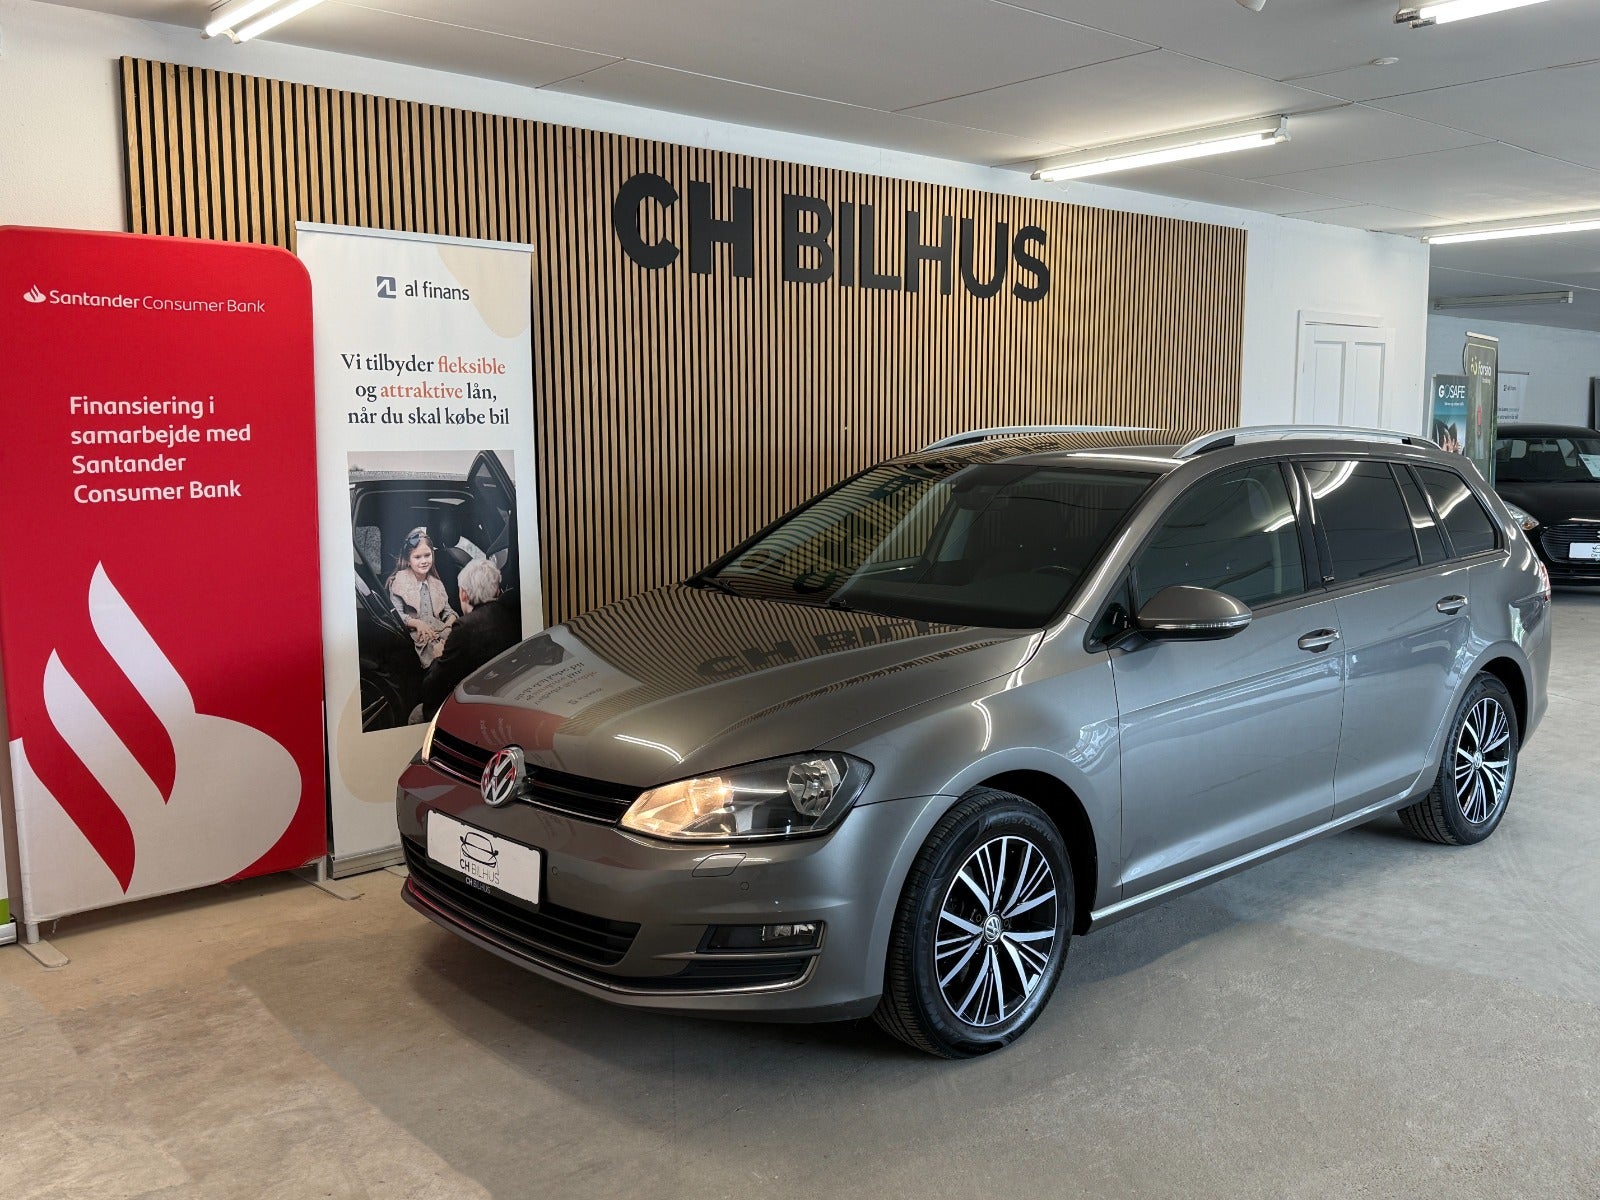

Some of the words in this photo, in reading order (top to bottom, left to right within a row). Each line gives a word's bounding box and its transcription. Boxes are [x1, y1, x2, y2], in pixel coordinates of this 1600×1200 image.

[614, 172, 752, 278] CH
[784, 193, 1050, 302] BILHUS
[49, 289, 140, 309] Santander
[142, 296, 224, 312] Consumer
[227, 299, 266, 313] Bank
[404, 279, 418, 297] al
[422, 280, 470, 301] finans
[340, 353, 362, 370] Vi
[366, 353, 434, 376] tilbyder
[438, 355, 506, 375] fleksible
[355, 384, 377, 402] og
[380, 381, 463, 399] attraktive
[467, 382, 497, 402] lån,
[69, 395, 204, 419] Finansiering
[208, 395, 215, 414] i
[347, 406, 377, 424] når
[380, 406, 403, 424] du
[408, 406, 441, 424] skal
[444, 406, 486, 425] købe
[489, 407, 510, 425] bil
[70, 424, 201, 448] samarbejde
[205, 423, 251, 442] med
[71, 453, 187, 475] Santander
[73, 483, 185, 504] Consumer
[189, 480, 242, 499] Bank
[460, 858, 470, 873] CH
[471, 863, 500, 885] BILHUS
